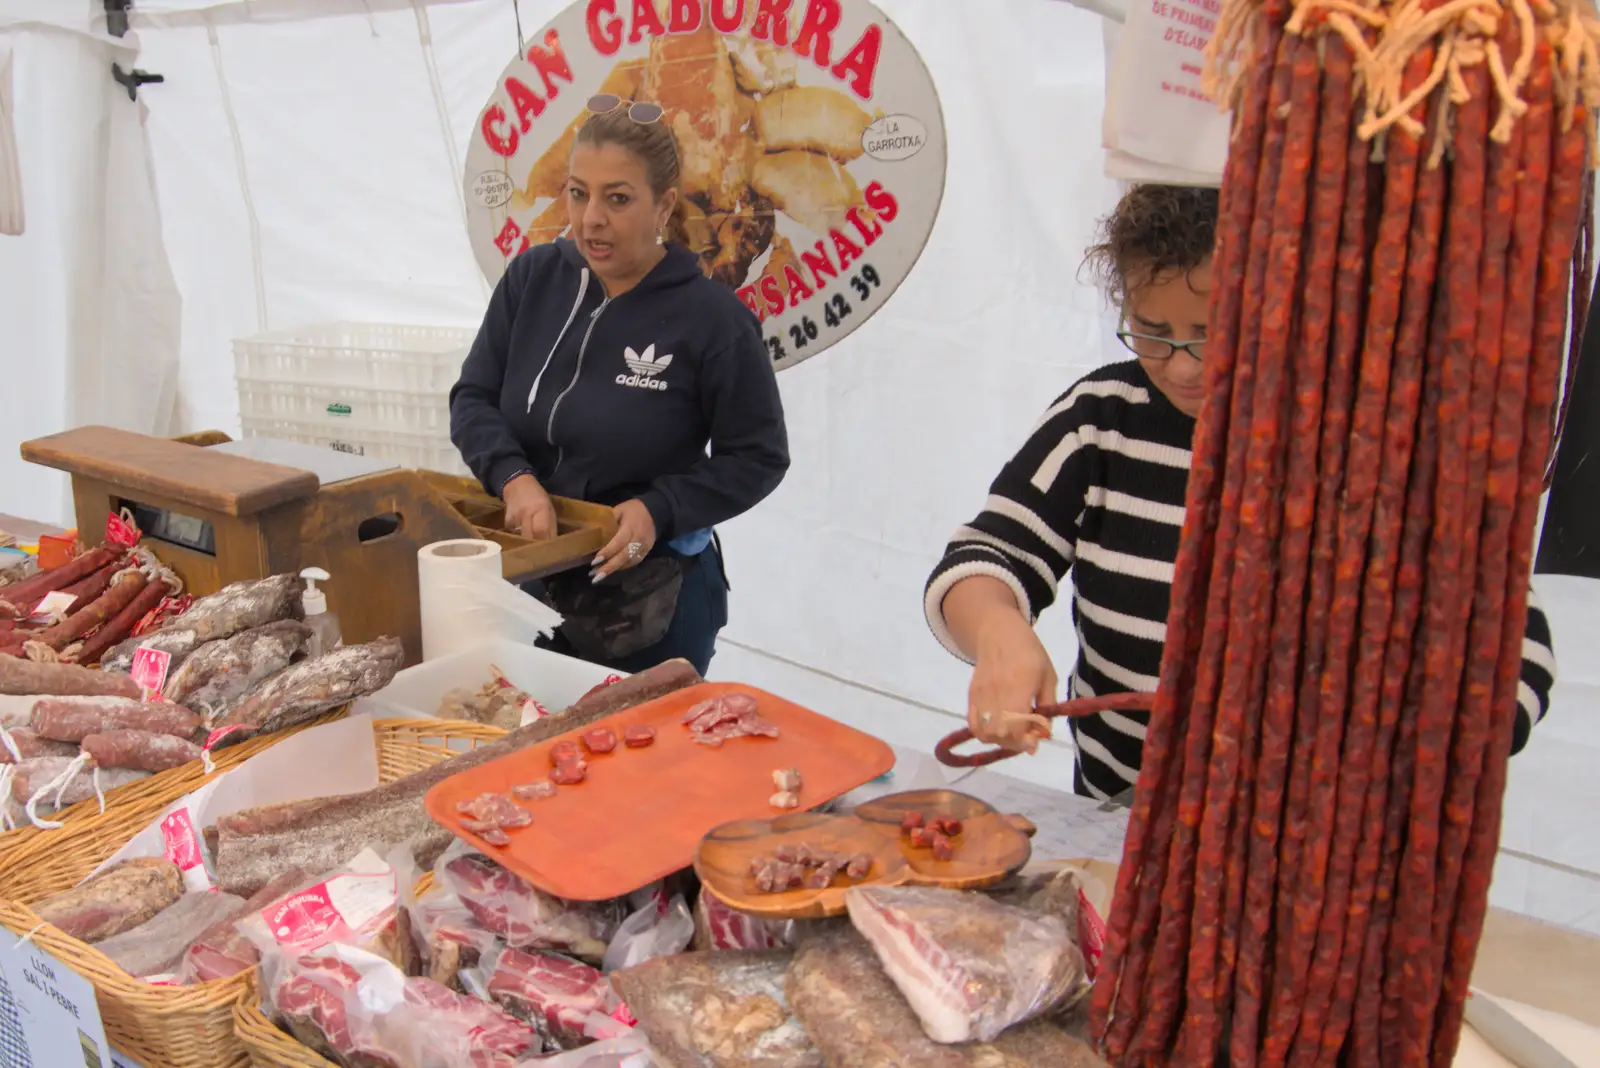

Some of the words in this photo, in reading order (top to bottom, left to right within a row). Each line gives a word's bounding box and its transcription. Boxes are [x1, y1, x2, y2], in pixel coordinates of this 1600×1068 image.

[482, 28, 573, 157] CAN
[586, 0, 882, 101] GABURRA
[886, 122, 900, 134] LA
[868, 136, 921, 153] GARROTXA
[789, 316, 818, 349] 26
[824, 293, 853, 328] 42
[850, 264, 881, 301] 39
[615, 374, 668, 391] adidas
[30, 955, 57, 984] LLOM
[23, 968, 43, 991] SAL
[50, 986, 81, 1020] PEBRE
